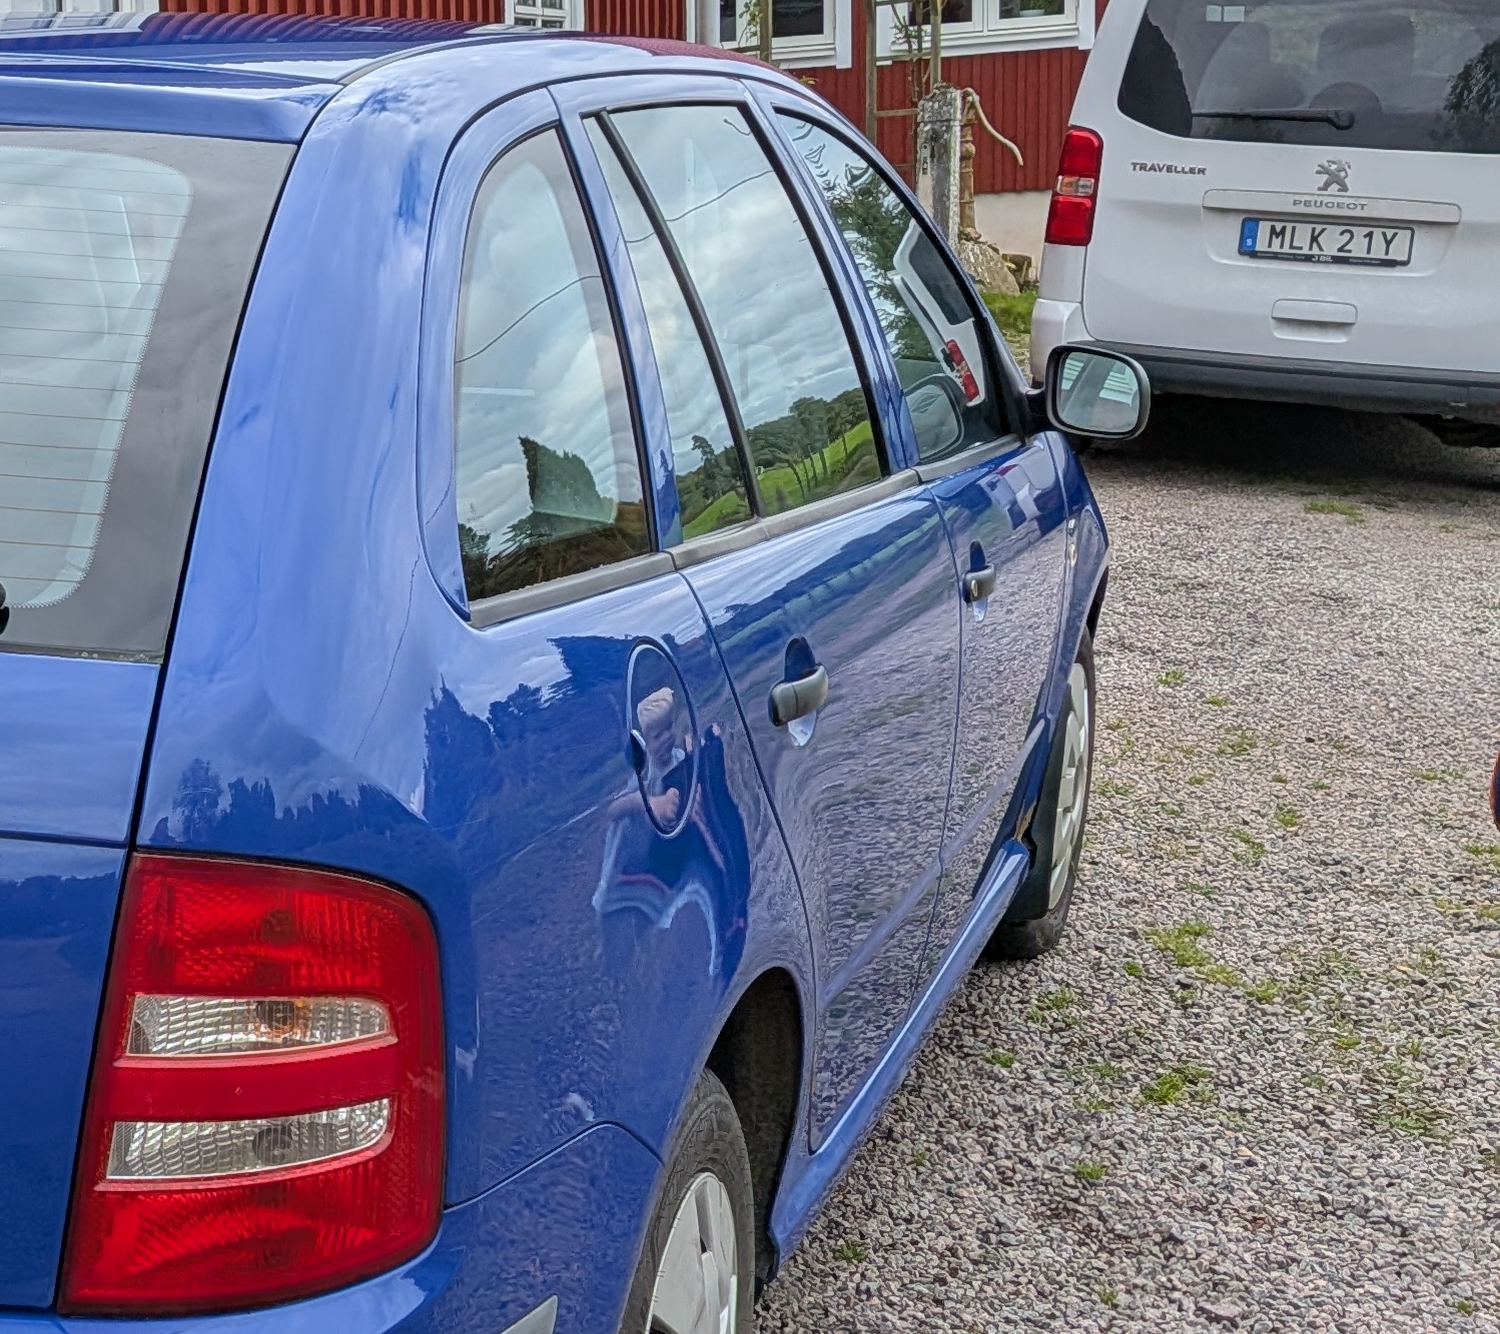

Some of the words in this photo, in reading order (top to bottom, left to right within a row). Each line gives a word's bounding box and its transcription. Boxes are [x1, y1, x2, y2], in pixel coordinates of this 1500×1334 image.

[1130, 162, 1207, 175] TRAVELLER
[1292, 199, 1368, 210] PEUGEOT
[1267, 224, 1327, 252] MLK
[1337, 228, 1399, 256] 21Y
